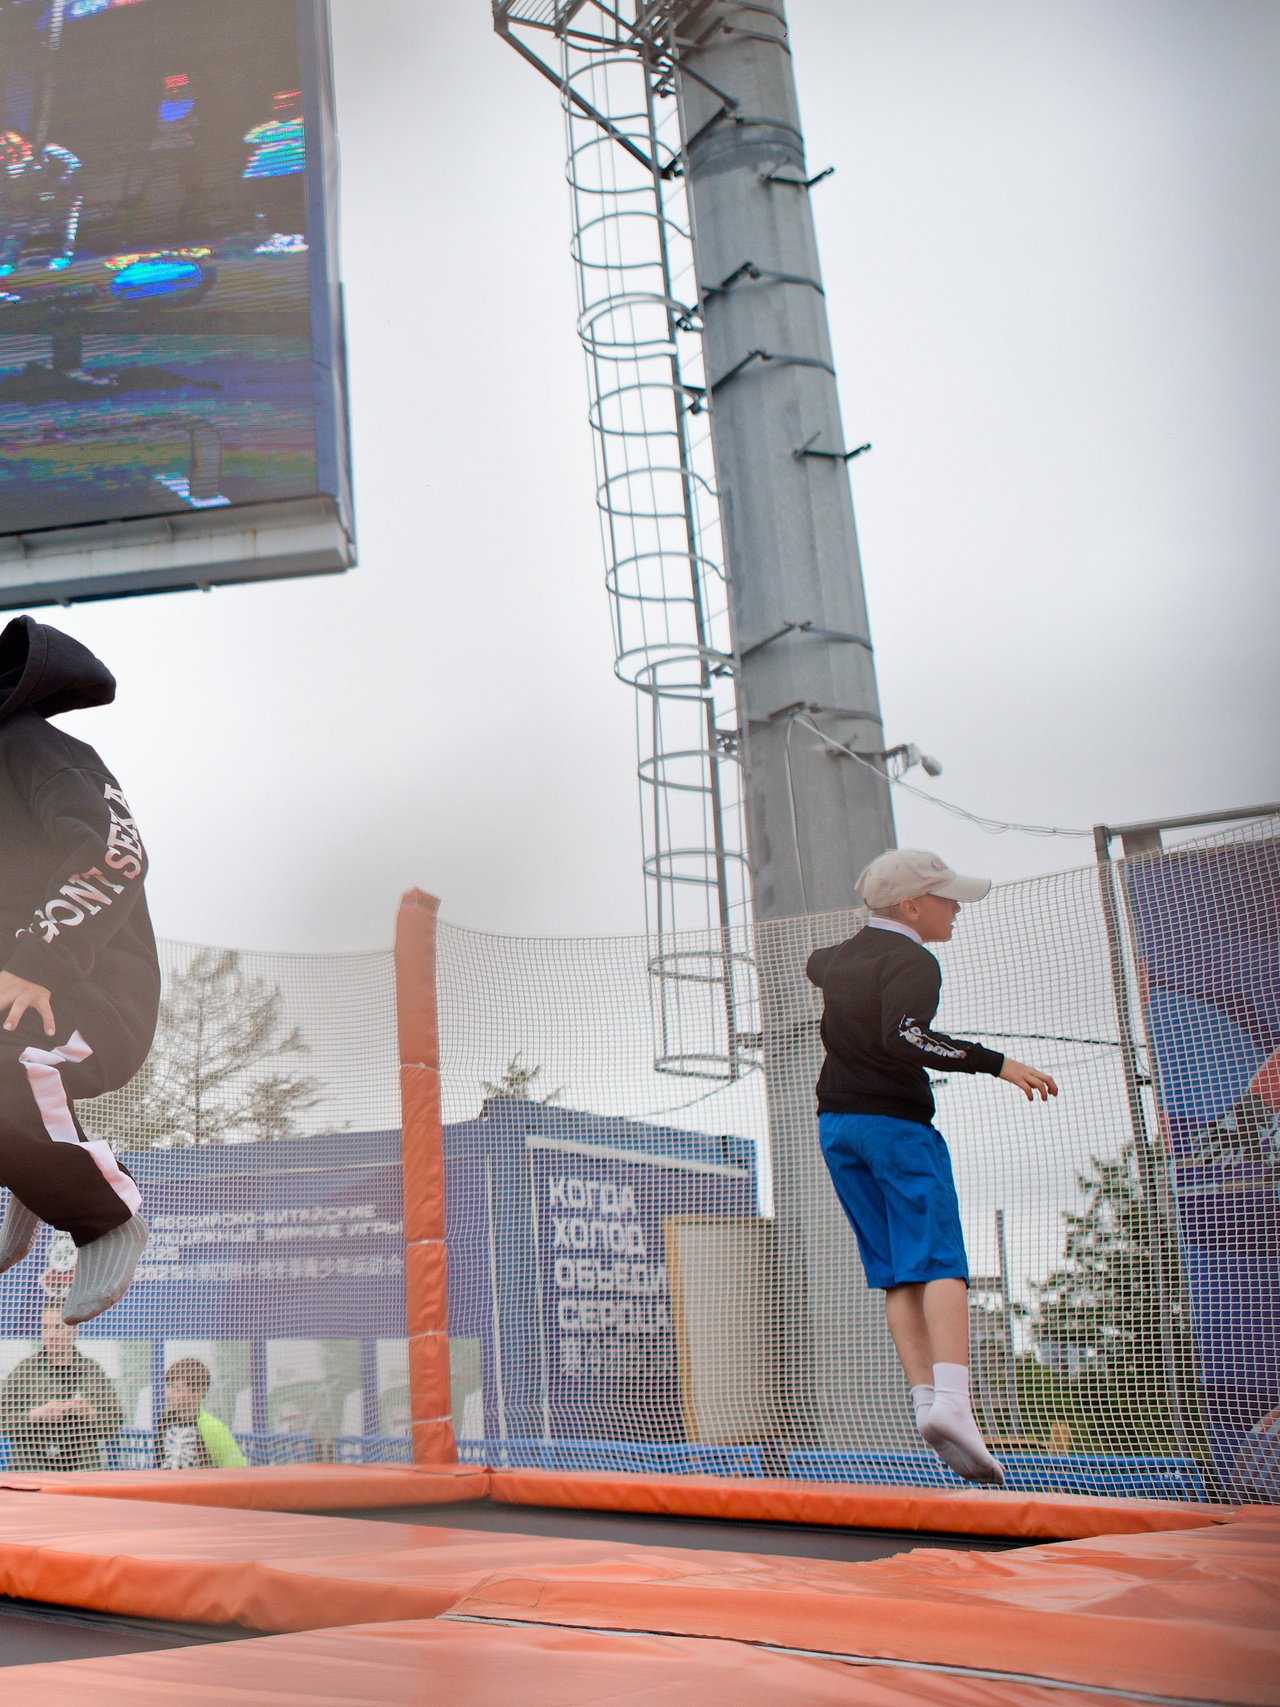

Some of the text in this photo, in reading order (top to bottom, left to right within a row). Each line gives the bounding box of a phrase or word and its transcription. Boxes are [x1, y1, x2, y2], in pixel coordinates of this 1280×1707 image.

[549, 1174, 638, 1217] КОГДА
[263, 1222, 344, 1241] ЗИМНИЕ
[349, 1218, 404, 1236] ИГРЫ
[551, 1216, 647, 1259] ХОЛОД
[558, 1298, 673, 1333] СЕРДЦА
